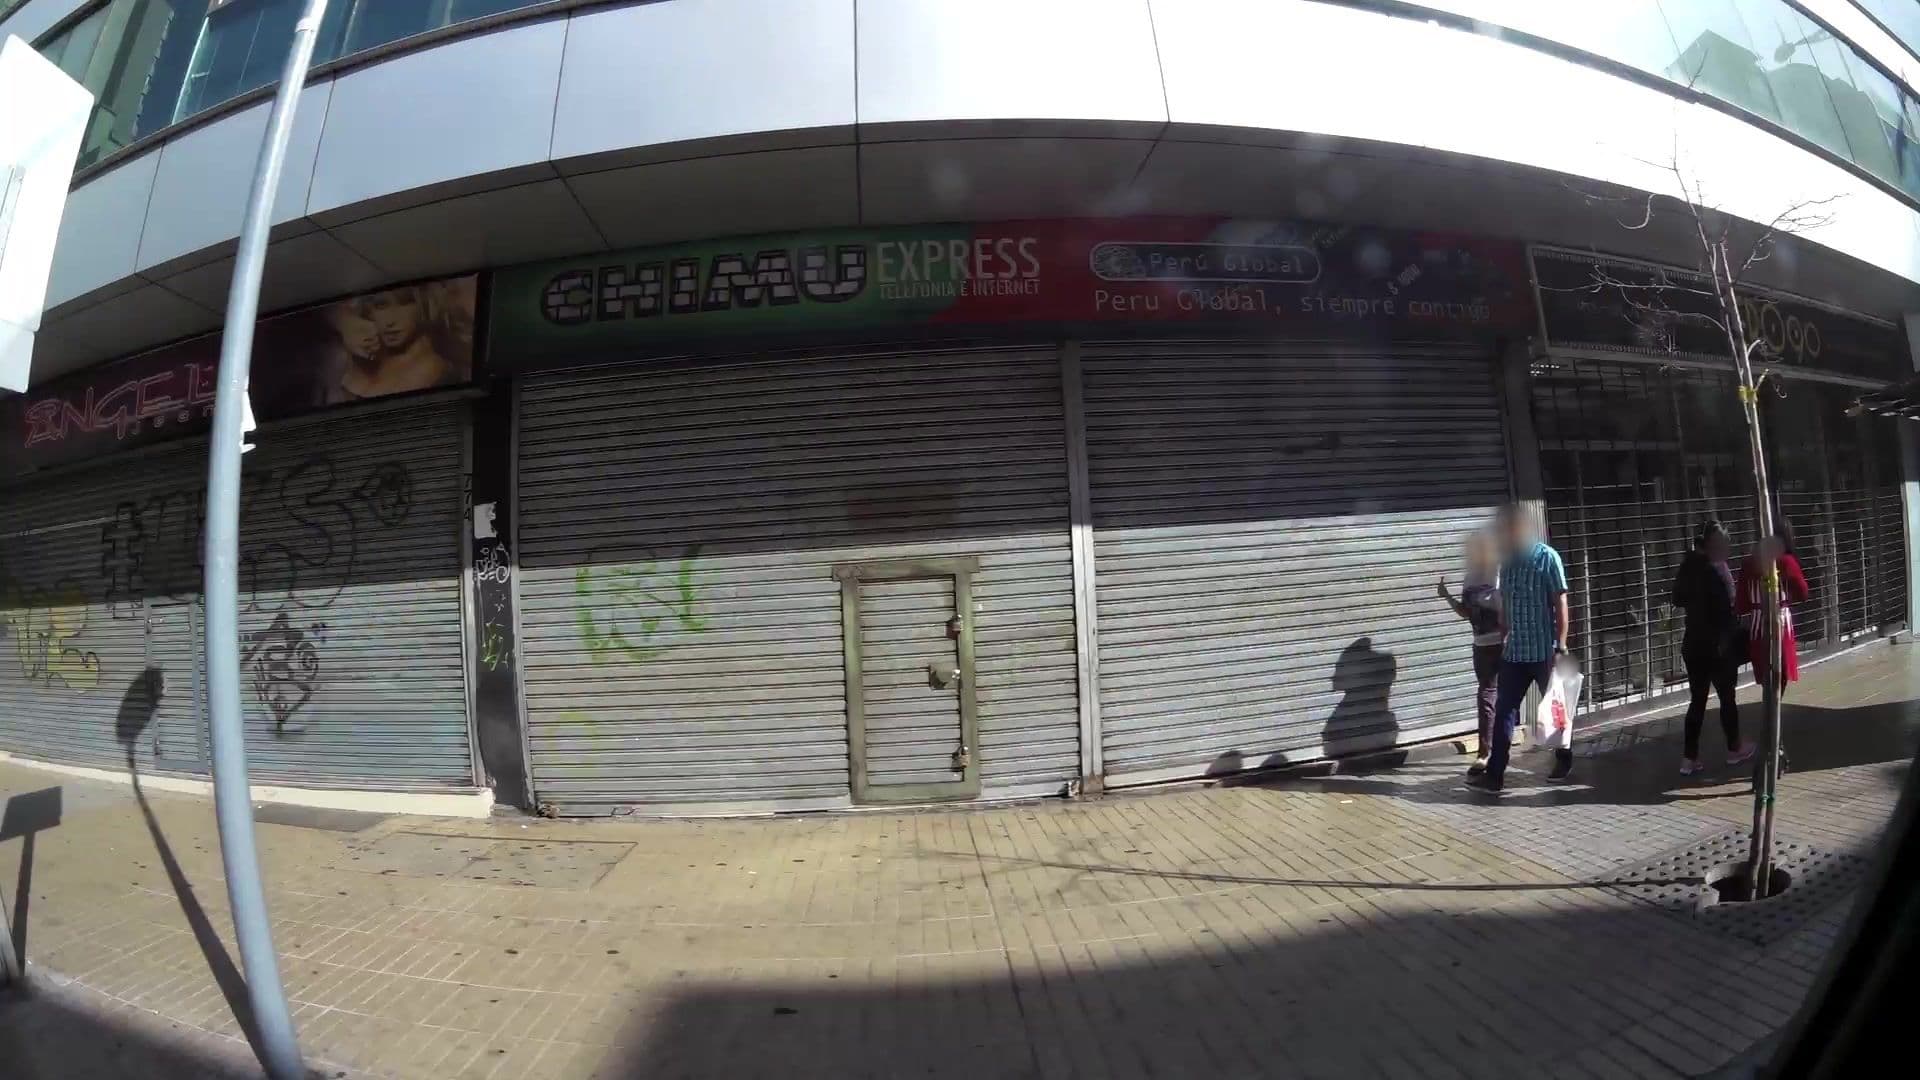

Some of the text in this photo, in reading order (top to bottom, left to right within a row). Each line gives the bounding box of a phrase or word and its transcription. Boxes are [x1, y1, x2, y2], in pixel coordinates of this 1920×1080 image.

[1223, 252, 1305, 275] Global
[540, 237, 1040, 326] CHIMU EXPRESS
[973, 279, 1040, 297] INTERNET
[1094, 288, 1160, 313] Peru
